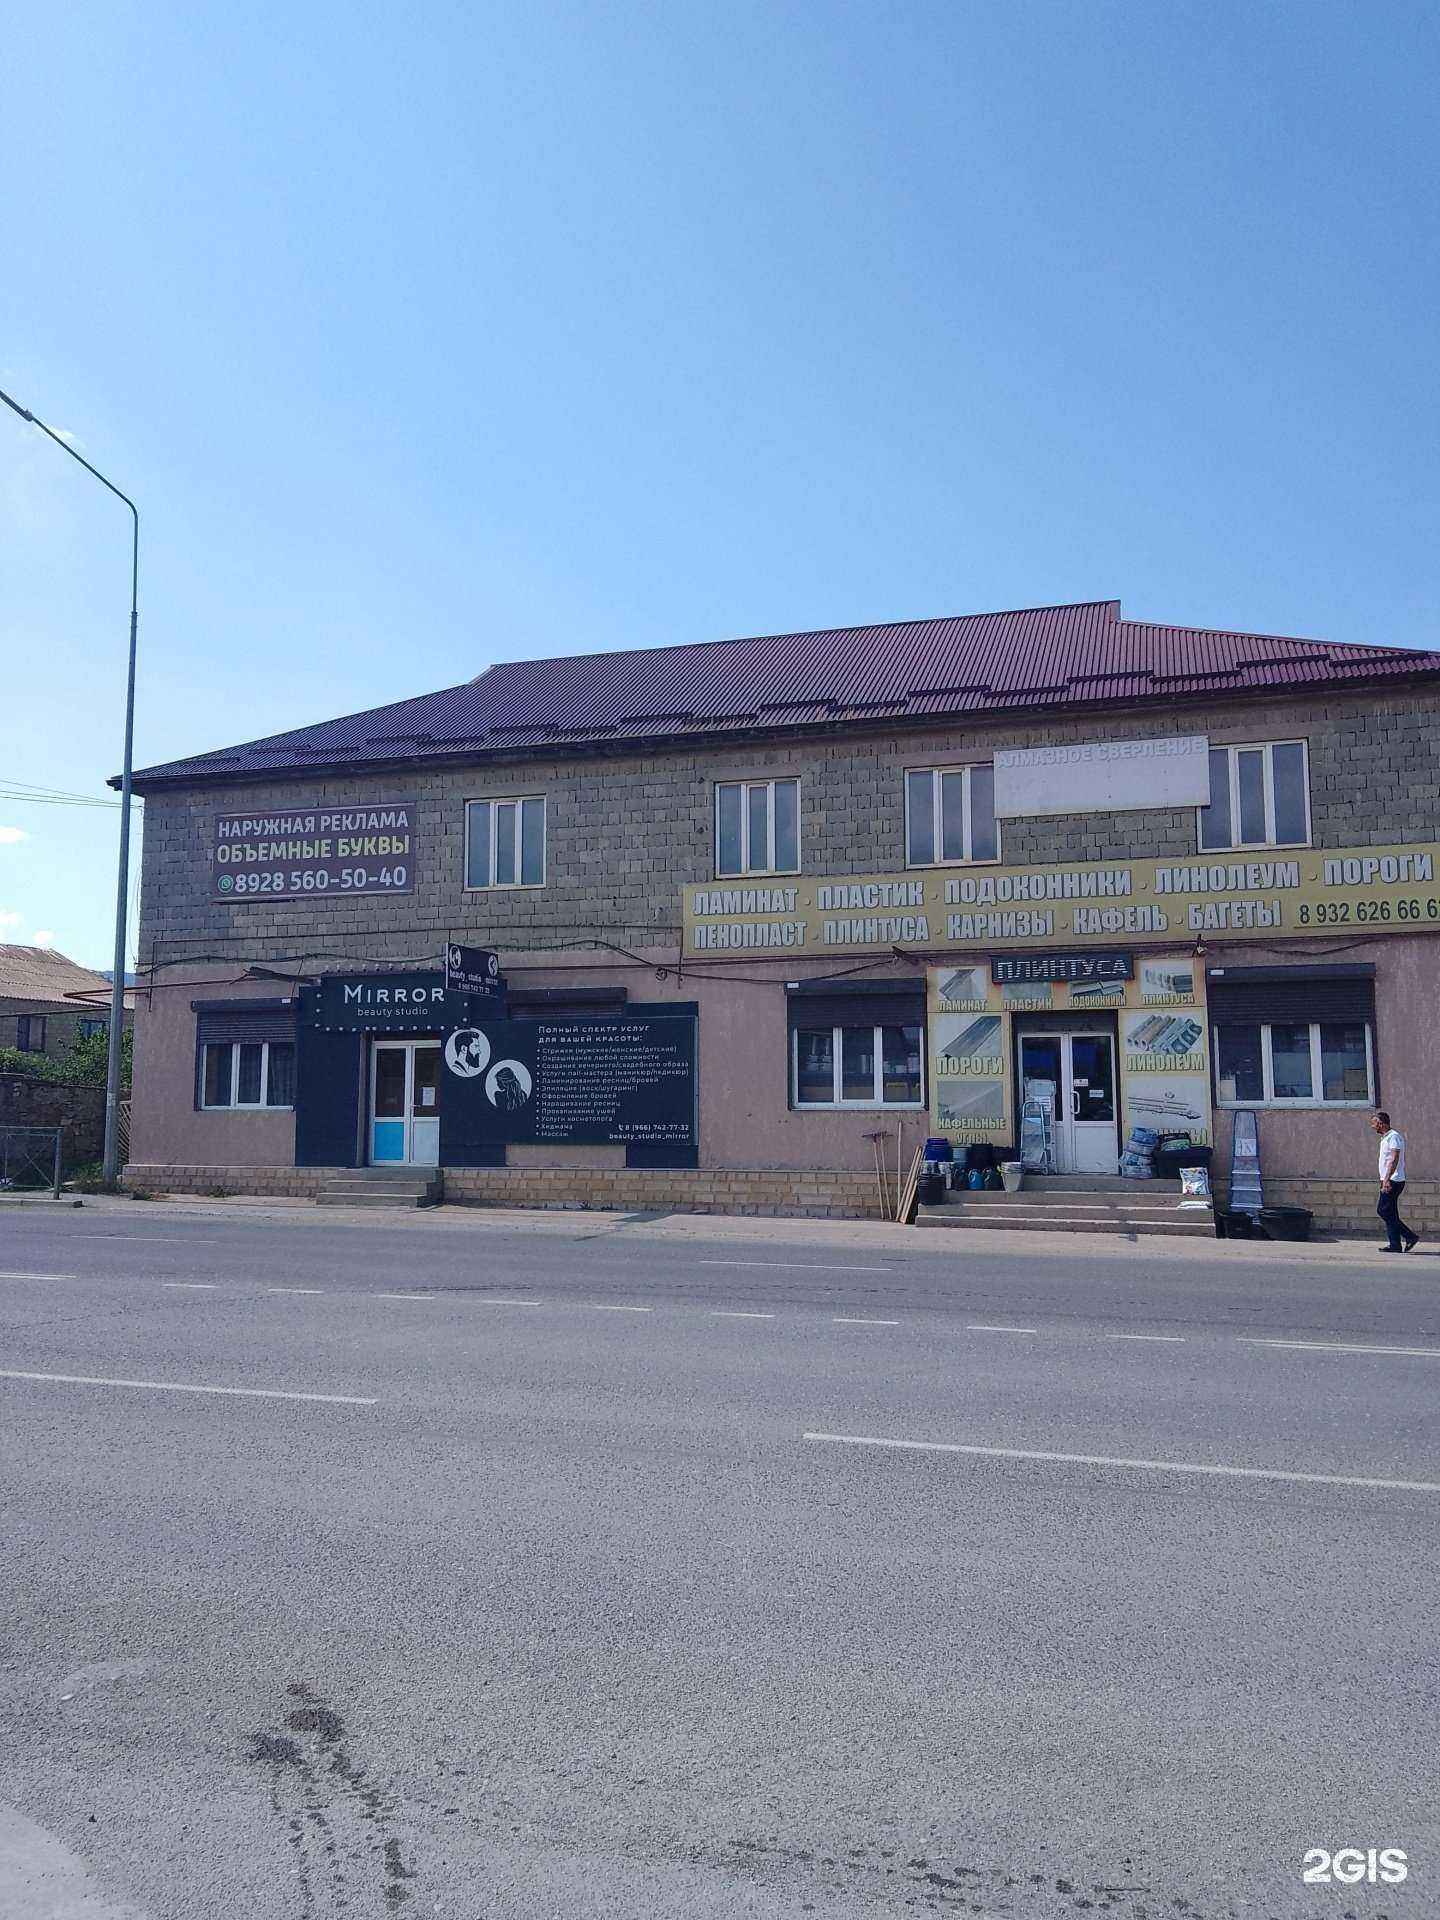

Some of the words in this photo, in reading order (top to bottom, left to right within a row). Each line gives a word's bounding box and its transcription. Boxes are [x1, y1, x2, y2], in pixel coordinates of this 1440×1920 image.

[1096, 739, 1204, 761] СВЕРЛЕНИЕ
[218, 813, 316, 838] НАРУЖНАЯ
[320, 810, 409, 832] РЕКЛАМА
[217, 838, 332, 864] ОБЪЕМНЫЕ
[338, 834, 410, 858] БУКВЫ
[235, 871, 284, 892] 8928
[290, 866, 406, 891] 560-50-40
[693, 888, 798, 916] ЛАМИНАТ
[816, 881, 925, 911] ПЛАСТИК
[945, 870, 1132, 907] ПОДОКОННИКИ
[1154, 862, 1300, 894] ЛИНОЛЕУМ
[1324, 854, 1432, 886] ПОРОГИ
[1300, 904, 1310, 924] 8
[1316, 902, 1350, 922] 932
[1357, 901, 1390, 921] 626
[1398, 900, 1420, 920] 66
[1426, 898, 1440, 918] 6
[694, 920, 807, 949] ПЕНОПЛАСТ
[822, 915, 930, 944] ПЛИНТУСА
[947, 910, 1054, 940] КАРНИЗЫ
[1072, 904, 1168, 934] КАФЕЛЬ
[1188, 900, 1282, 930] БАГЕТЫ
[997, 958, 1128, 979] ПЛИНТУСА
[358, 1008, 392, 1018] beauty
[395, 1007, 428, 1016] studio
[939, 1000, 988, 1012] ЛАМИНАТ
[1143, 992, 1195, 1006] ПЛИНТУСА
[936, 1056, 1004, 1074] ПОРОГИ
[1127, 1054, 1204, 1072] ЛИНОЛЕУМ
[938, 1118, 1007, 1130] КАФЕЛЬНЫЕ
